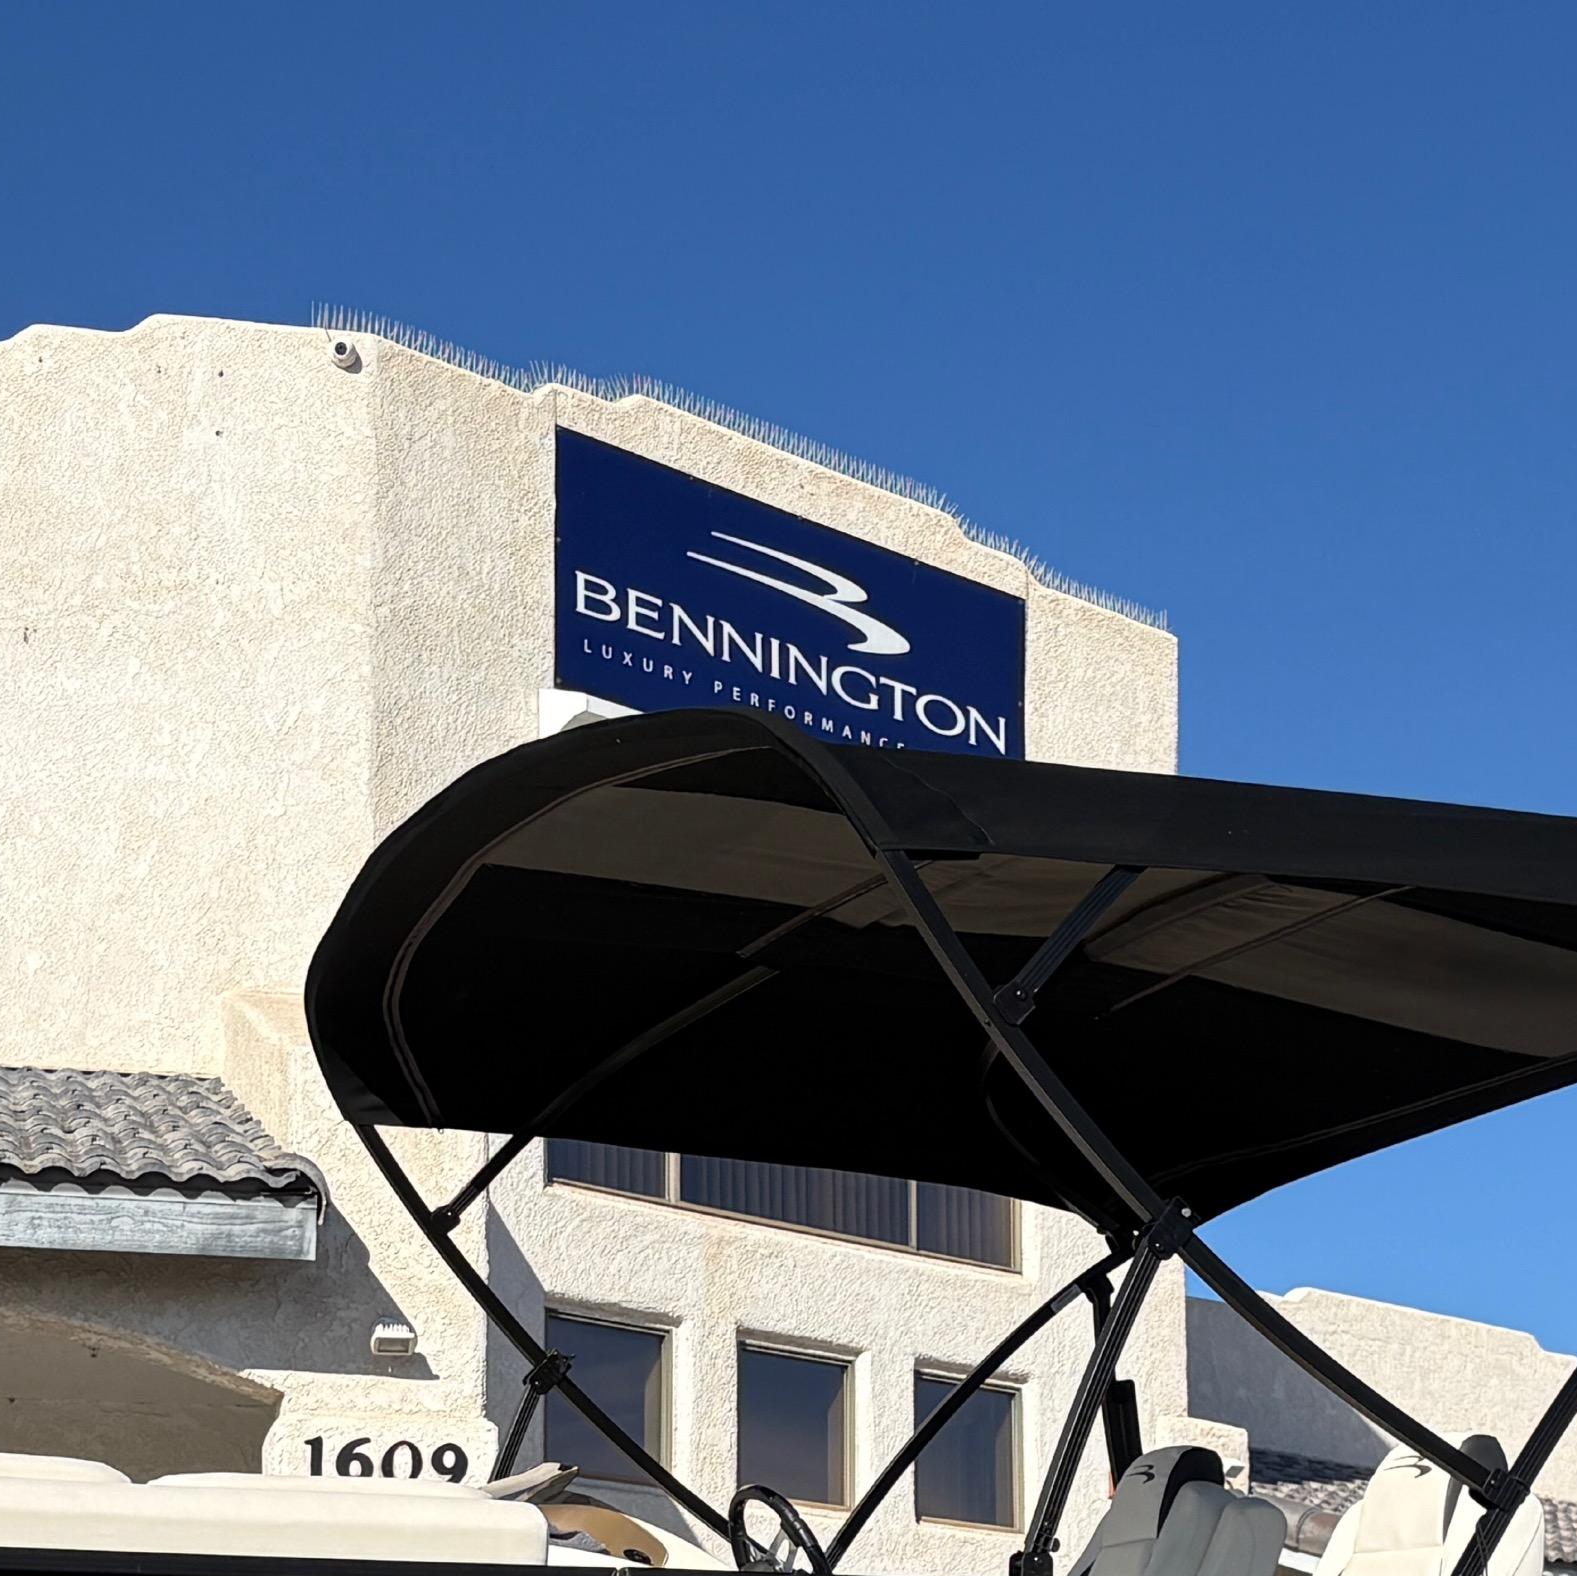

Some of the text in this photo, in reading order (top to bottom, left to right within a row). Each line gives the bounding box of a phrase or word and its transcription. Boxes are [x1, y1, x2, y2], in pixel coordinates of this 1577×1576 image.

[574, 570, 1007, 756] BENNINGTON
[583, 638, 693, 685] LUXURY
[304, 1436, 468, 1483] 1609
